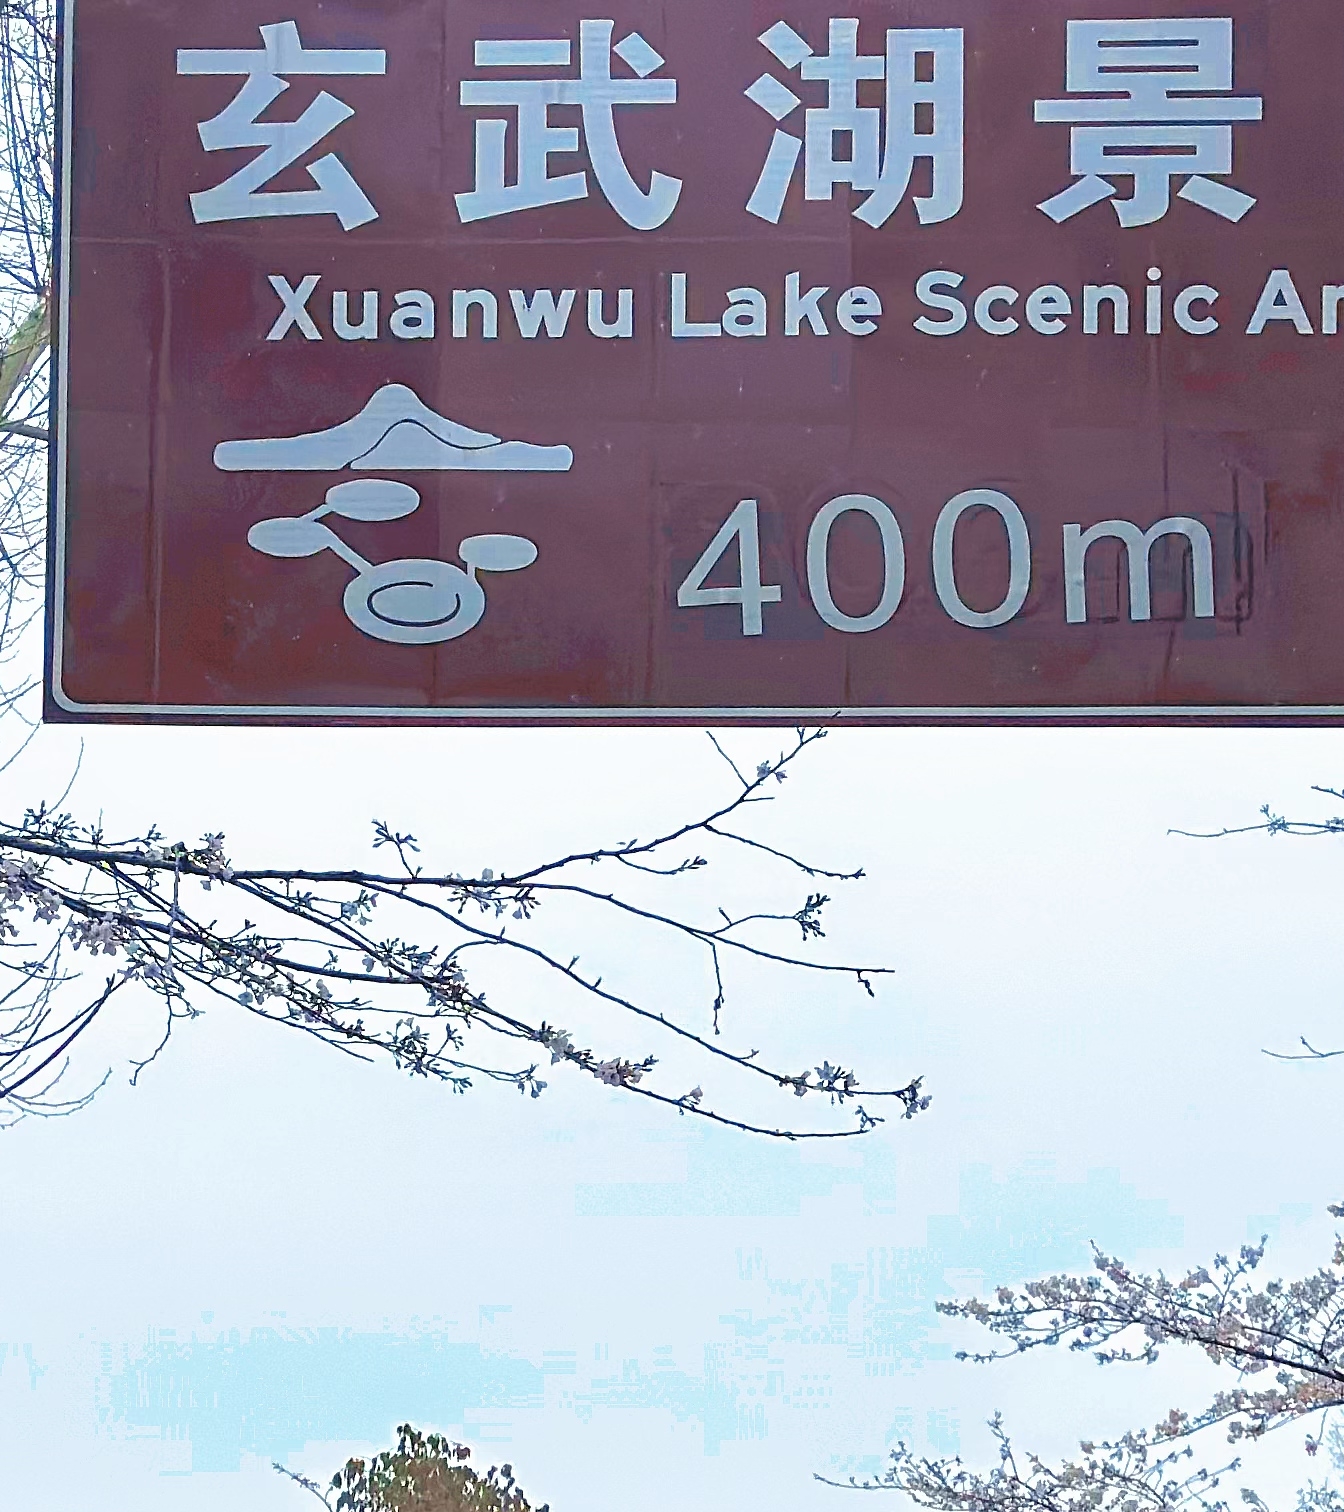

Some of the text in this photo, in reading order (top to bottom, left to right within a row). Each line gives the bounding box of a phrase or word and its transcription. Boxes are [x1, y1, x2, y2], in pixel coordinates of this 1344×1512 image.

[265, 274, 633, 341] Xuanwu
[671, 270, 883, 338] Lake
[912, 266, 1219, 336] Scenic
[676, 489, 1216, 637] 400m
